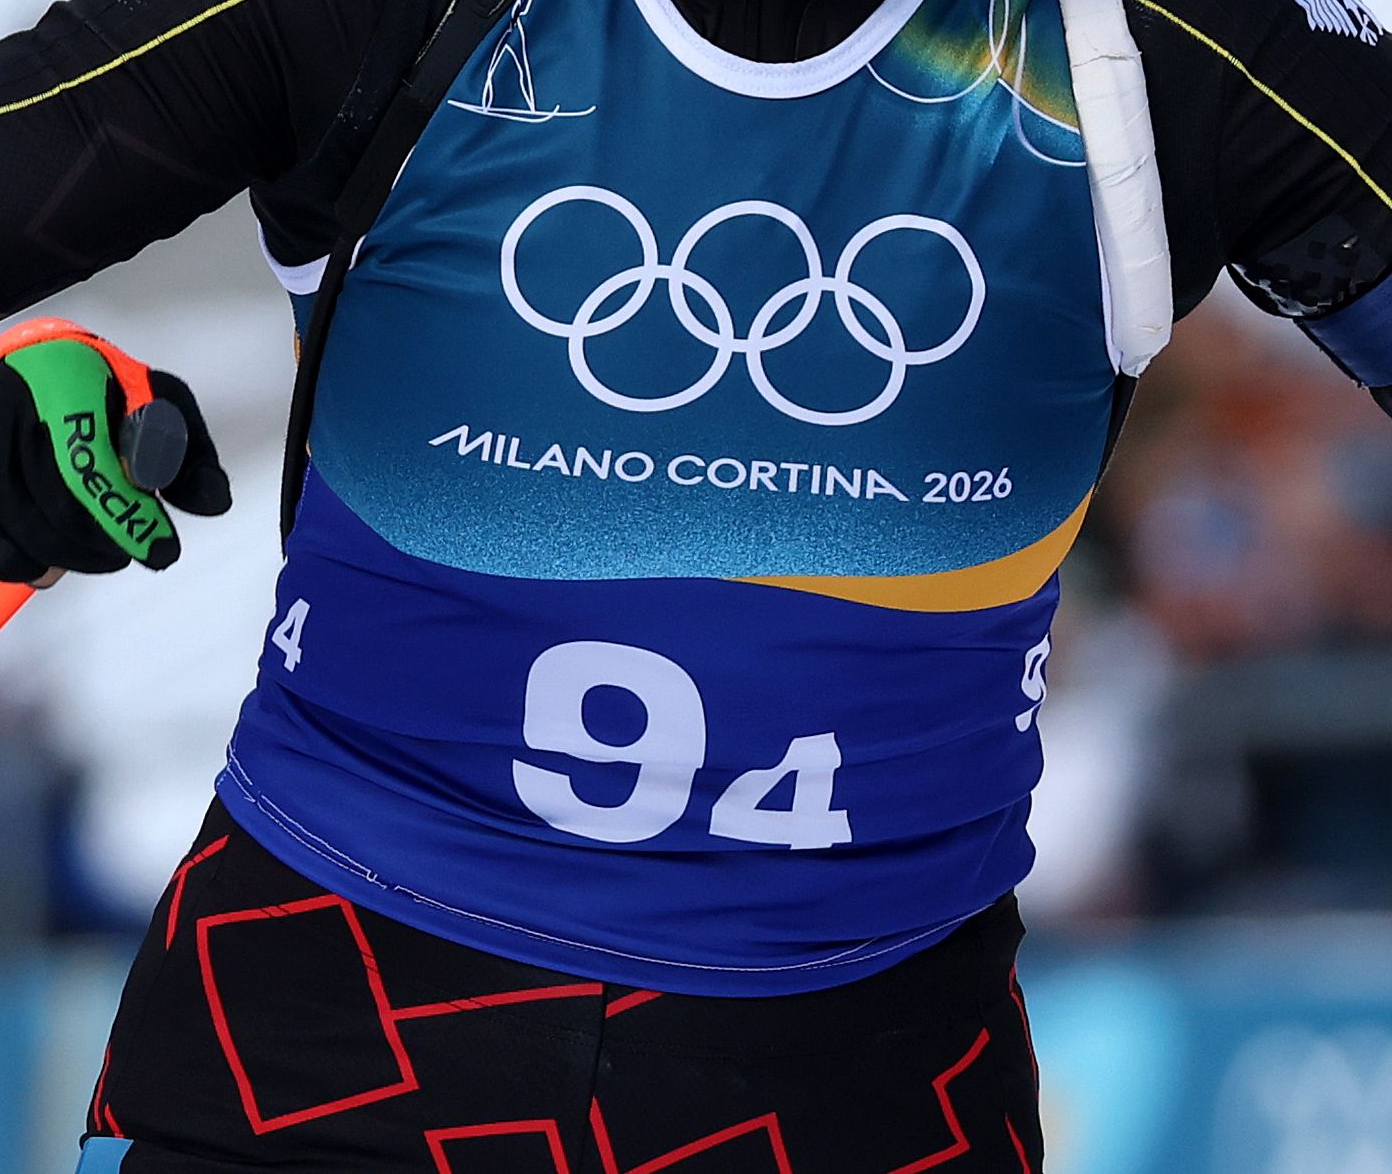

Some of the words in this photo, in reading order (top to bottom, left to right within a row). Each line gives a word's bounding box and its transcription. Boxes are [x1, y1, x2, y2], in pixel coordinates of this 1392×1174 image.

[428, 424, 654, 483] MILANO
[666, 453, 910, 503] CORTINA
[921, 467, 1014, 504] 2026
[271, 597, 311, 673] 4
